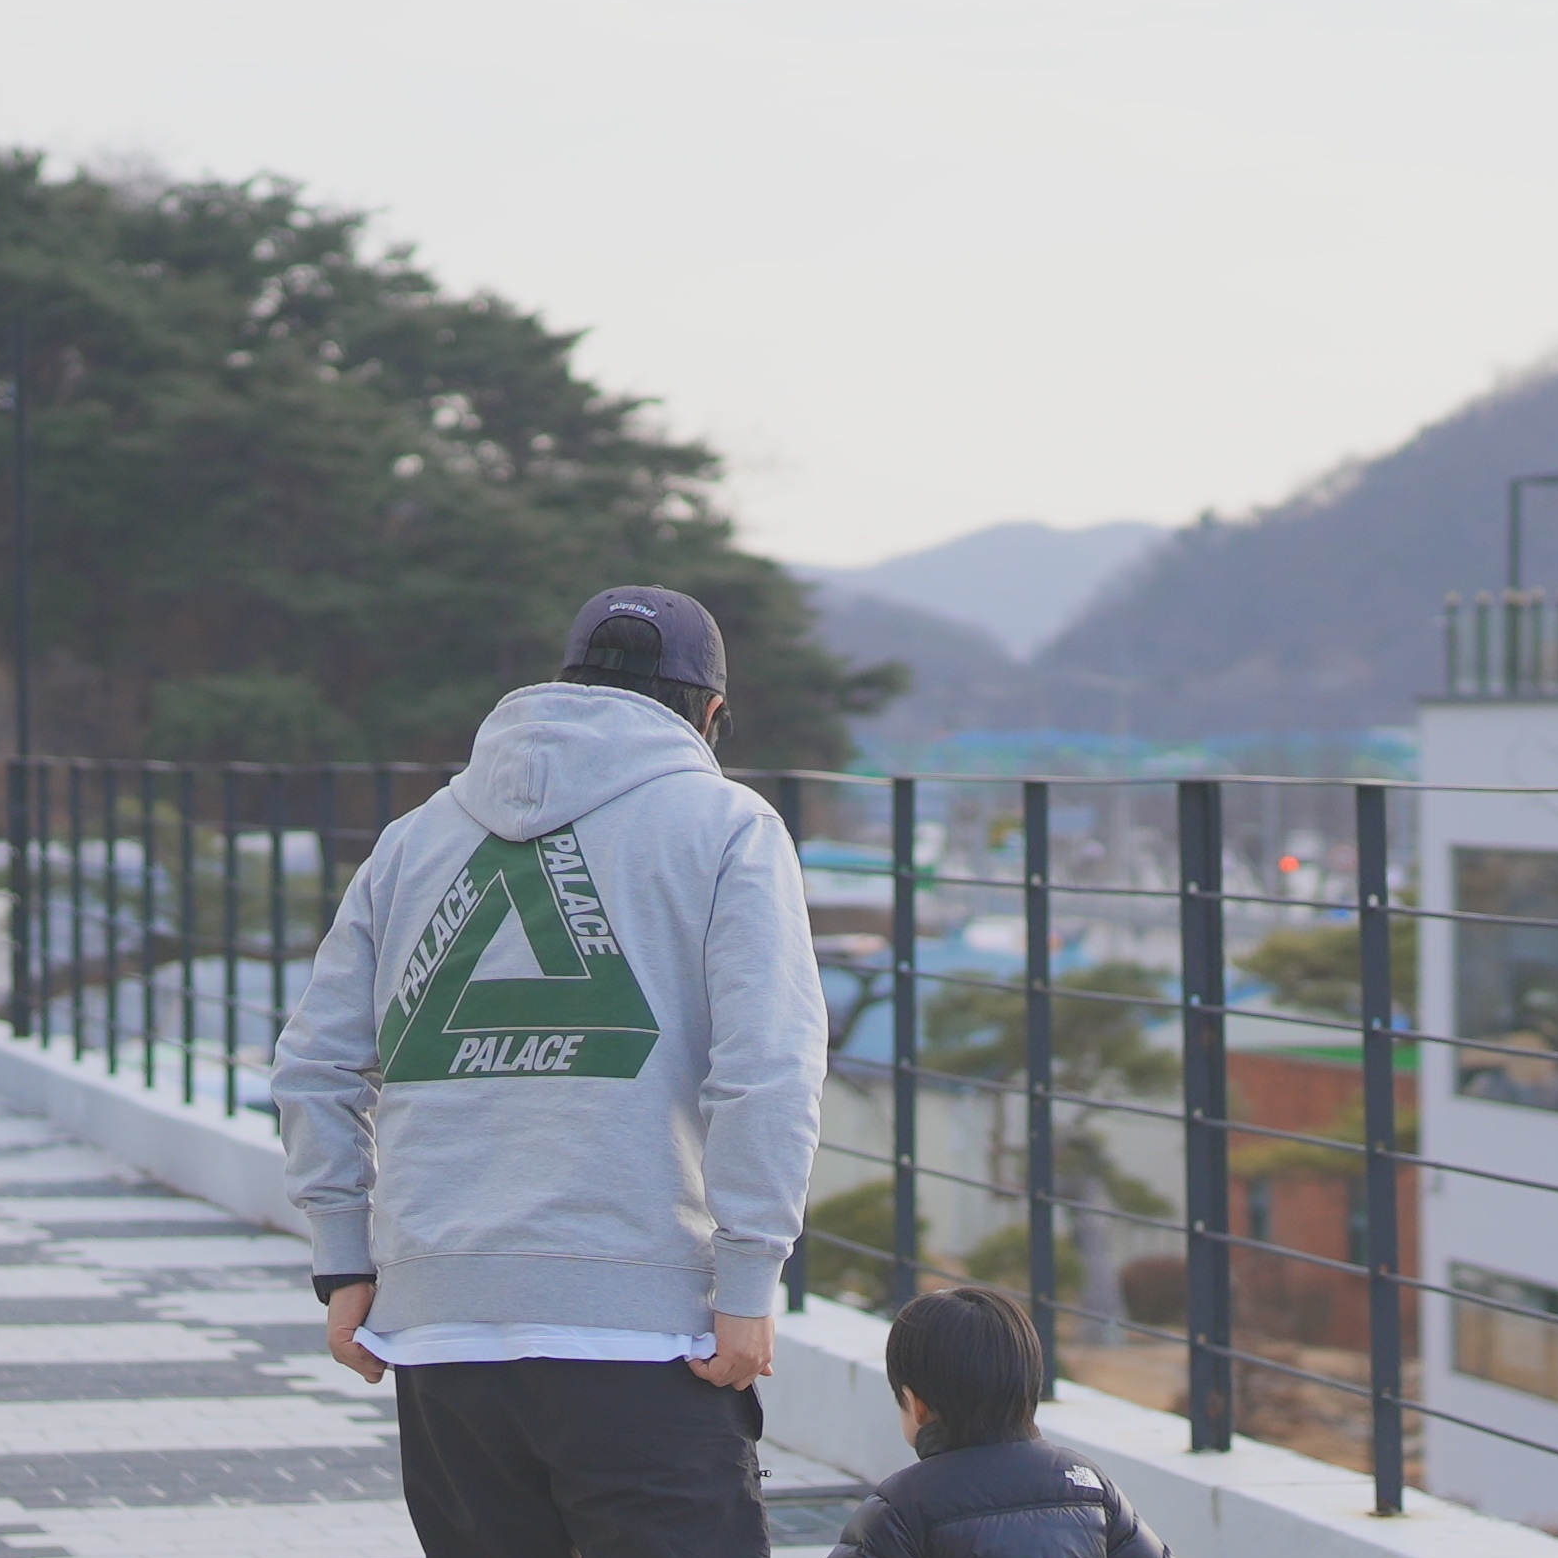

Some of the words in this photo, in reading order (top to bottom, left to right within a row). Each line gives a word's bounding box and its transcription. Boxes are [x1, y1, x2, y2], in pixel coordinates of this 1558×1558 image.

[397, 867, 479, 1017] PALACE
[542, 833, 620, 956] PALACE
[448, 1035, 585, 1074] PALACE
